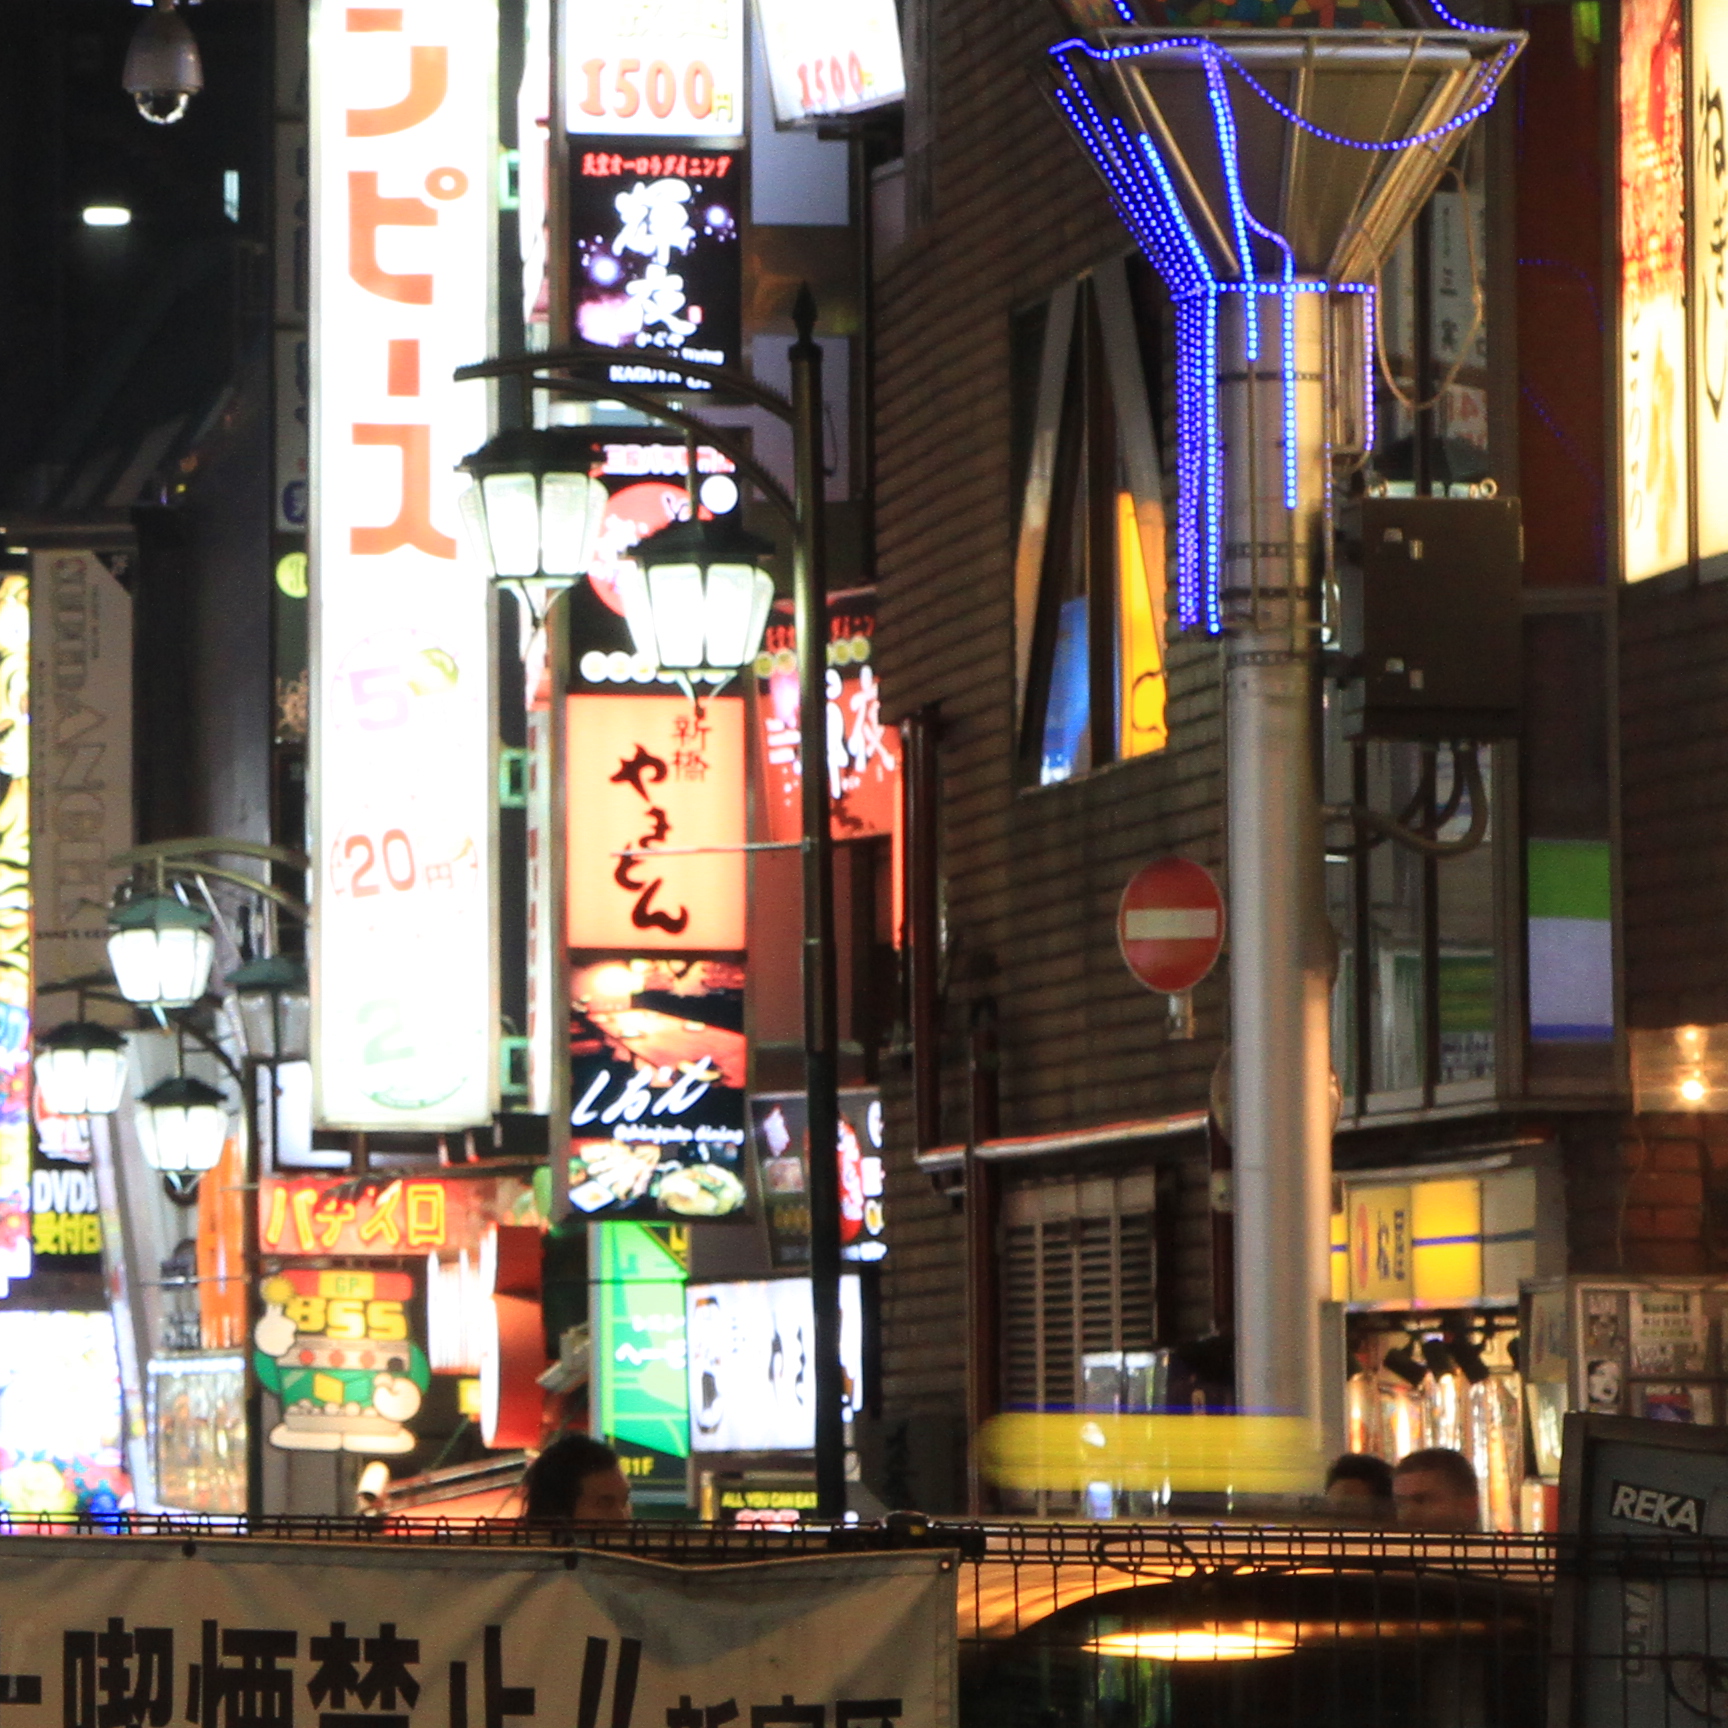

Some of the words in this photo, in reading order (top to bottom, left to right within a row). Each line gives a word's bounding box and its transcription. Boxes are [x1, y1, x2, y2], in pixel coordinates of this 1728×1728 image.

[670, 712, 711, 784] 新橋
[609, 742, 691, 936] やきとん
[265, 1179, 446, 1252] パチスロ
[1612, 1484, 1699, 1535] REKA
